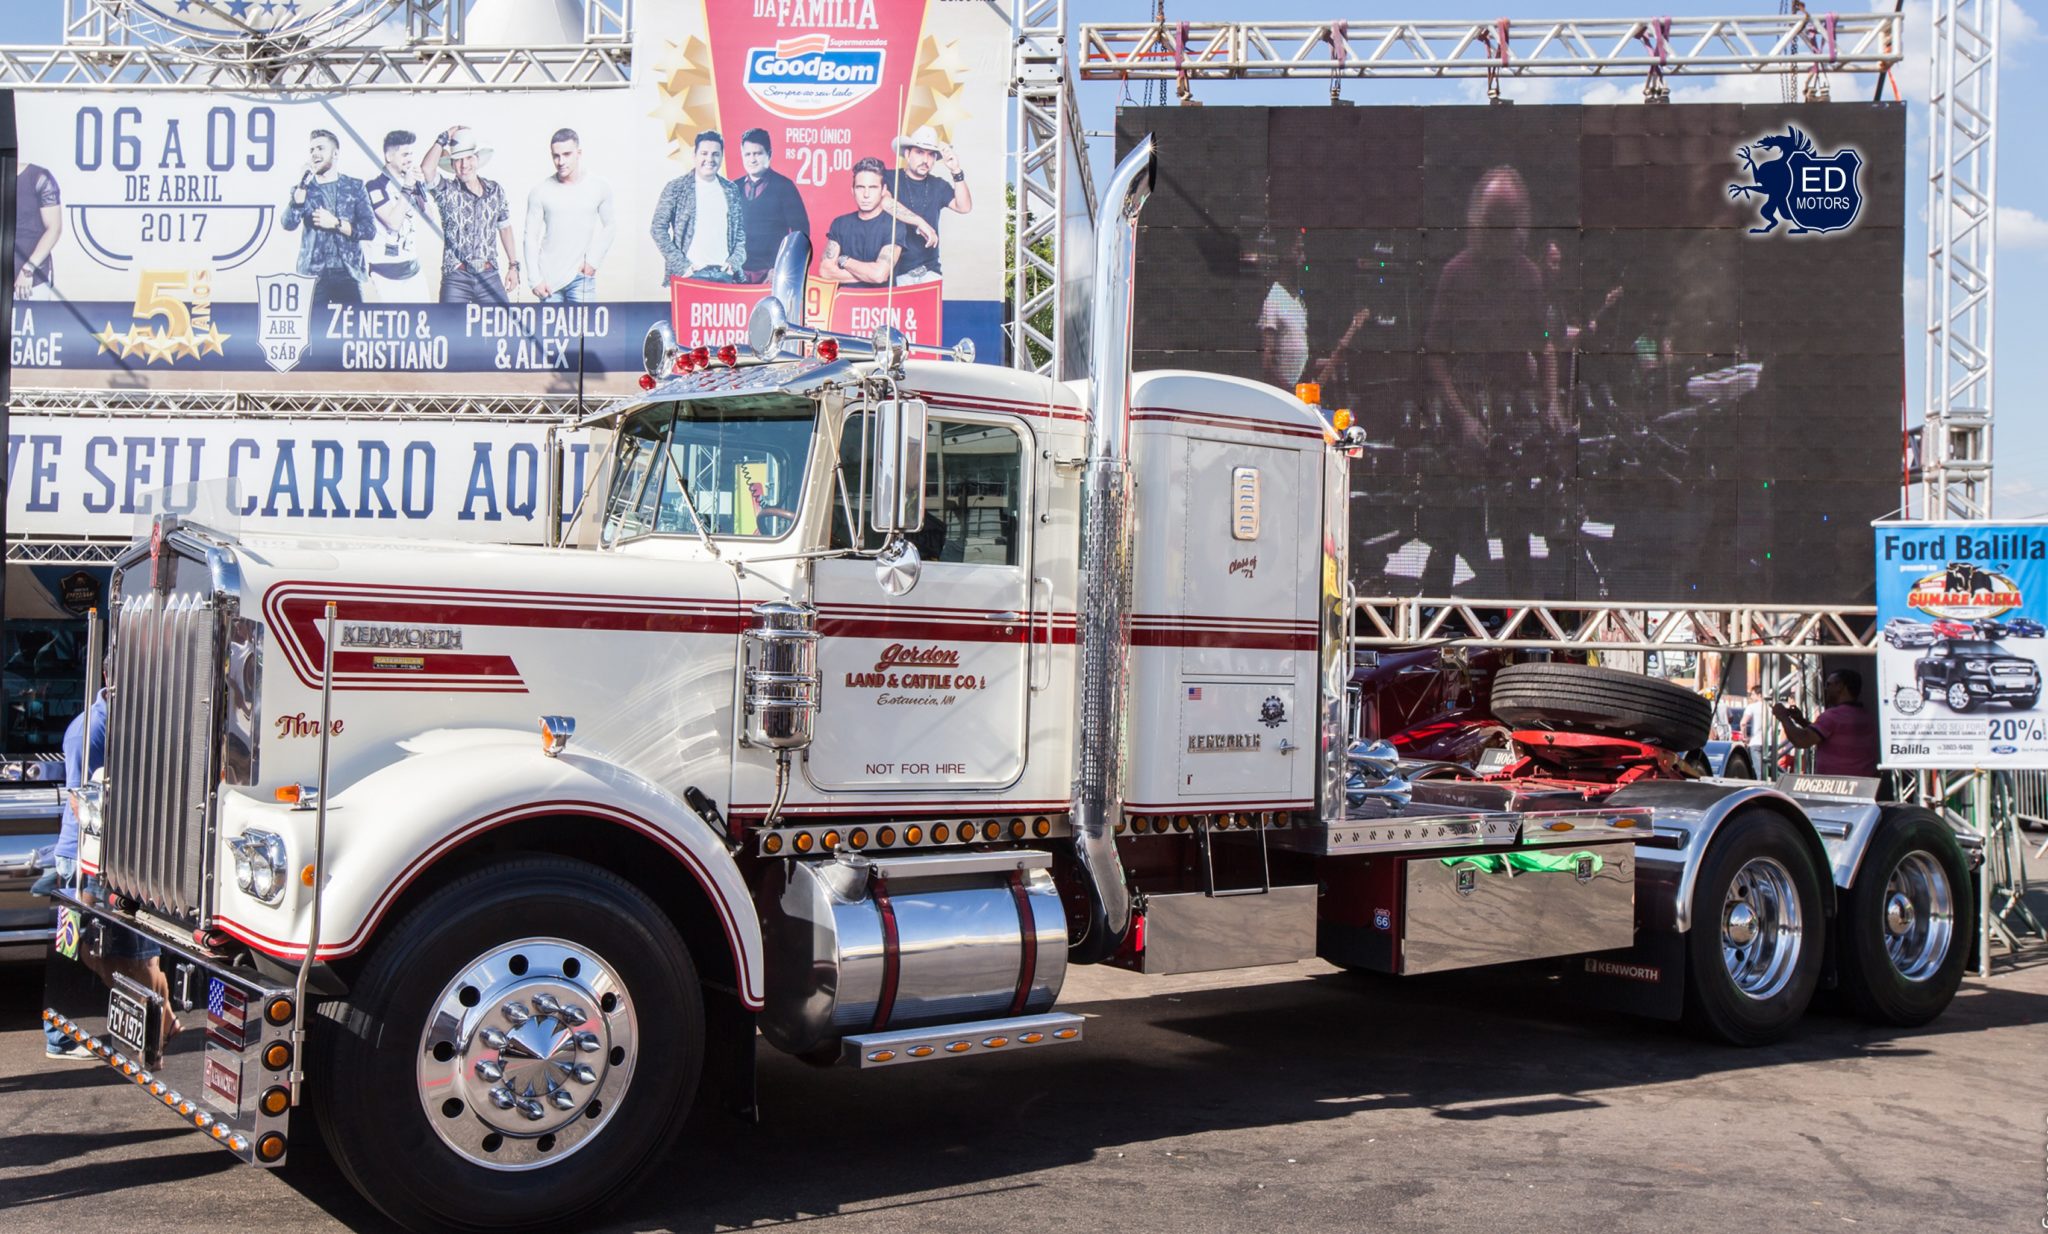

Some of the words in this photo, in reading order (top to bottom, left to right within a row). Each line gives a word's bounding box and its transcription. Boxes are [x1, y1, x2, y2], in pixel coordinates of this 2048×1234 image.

[829, 38, 888, 47] Supermercados
[754, 55, 874, 81] GoodBom
[763, 85, 801, 98] Sempre
[831, 87, 853, 97] lado
[75, 106, 142, 172] 06
[158, 119, 186, 169] A
[206, 106, 275, 172] 09
[785, 128, 818, 145] PREÇO
[820, 126, 851, 144] ÚNICO
[796, 146, 852, 187] 20,00
[125, 175, 150, 202] DE
[158, 175, 222, 202] ABRIL
[141, 213, 208, 242] 2017
[132, 269, 191, 342] 5
[191, 270, 212, 332] ANOS
[268, 283, 299, 312] 08
[806, 286, 821, 317] 9
[269, 319, 296, 335] ABR
[325, 302, 354, 339] ZÉ
[358, 310, 410, 339] NETO
[415, 310, 431, 339] &
[466, 302, 536, 338] PEDRO
[542, 305, 609, 338] PAULO
[690, 303, 747, 328] BRUNO
[851, 307, 901, 330] EDSON
[904, 307, 918, 330] &
[690, 329, 701, 349] &
[270, 343, 297, 361] SÁB
[342, 335, 449, 370] CRISTIANO
[494, 339, 512, 370] &
[515, 338, 570, 370] ALEX
[82, 436, 206, 515] SEU
[225, 438, 436, 520] CARRO
[1884, 535, 1945, 561] Ford
[1955, 534, 2046, 561] Balilla
[1228, 557, 1249, 575] Class
[1249, 555, 1257, 570] of
[1972, 591, 2023, 608] ARENA
[343, 625, 463, 649] KENWORTH
[873, 642, 960, 673] Gordon
[845, 672, 886, 689] LAND
[886, 673, 899, 689] &
[901, 673, 952, 690] CATTLE
[274, 712, 345, 740] Thre
[1989, 719, 2043, 741] 20%
[1890, 744, 1931, 755] Balilla
[865, 763, 895, 775] NOT
[900, 763, 930, 775] FOR
[935, 763, 966, 775] HIRE
[1793, 777, 1859, 795] HOGEBUILT
[1376, 915, 1389, 927] 66
[1598, 962, 1659, 981] KENWORTH
